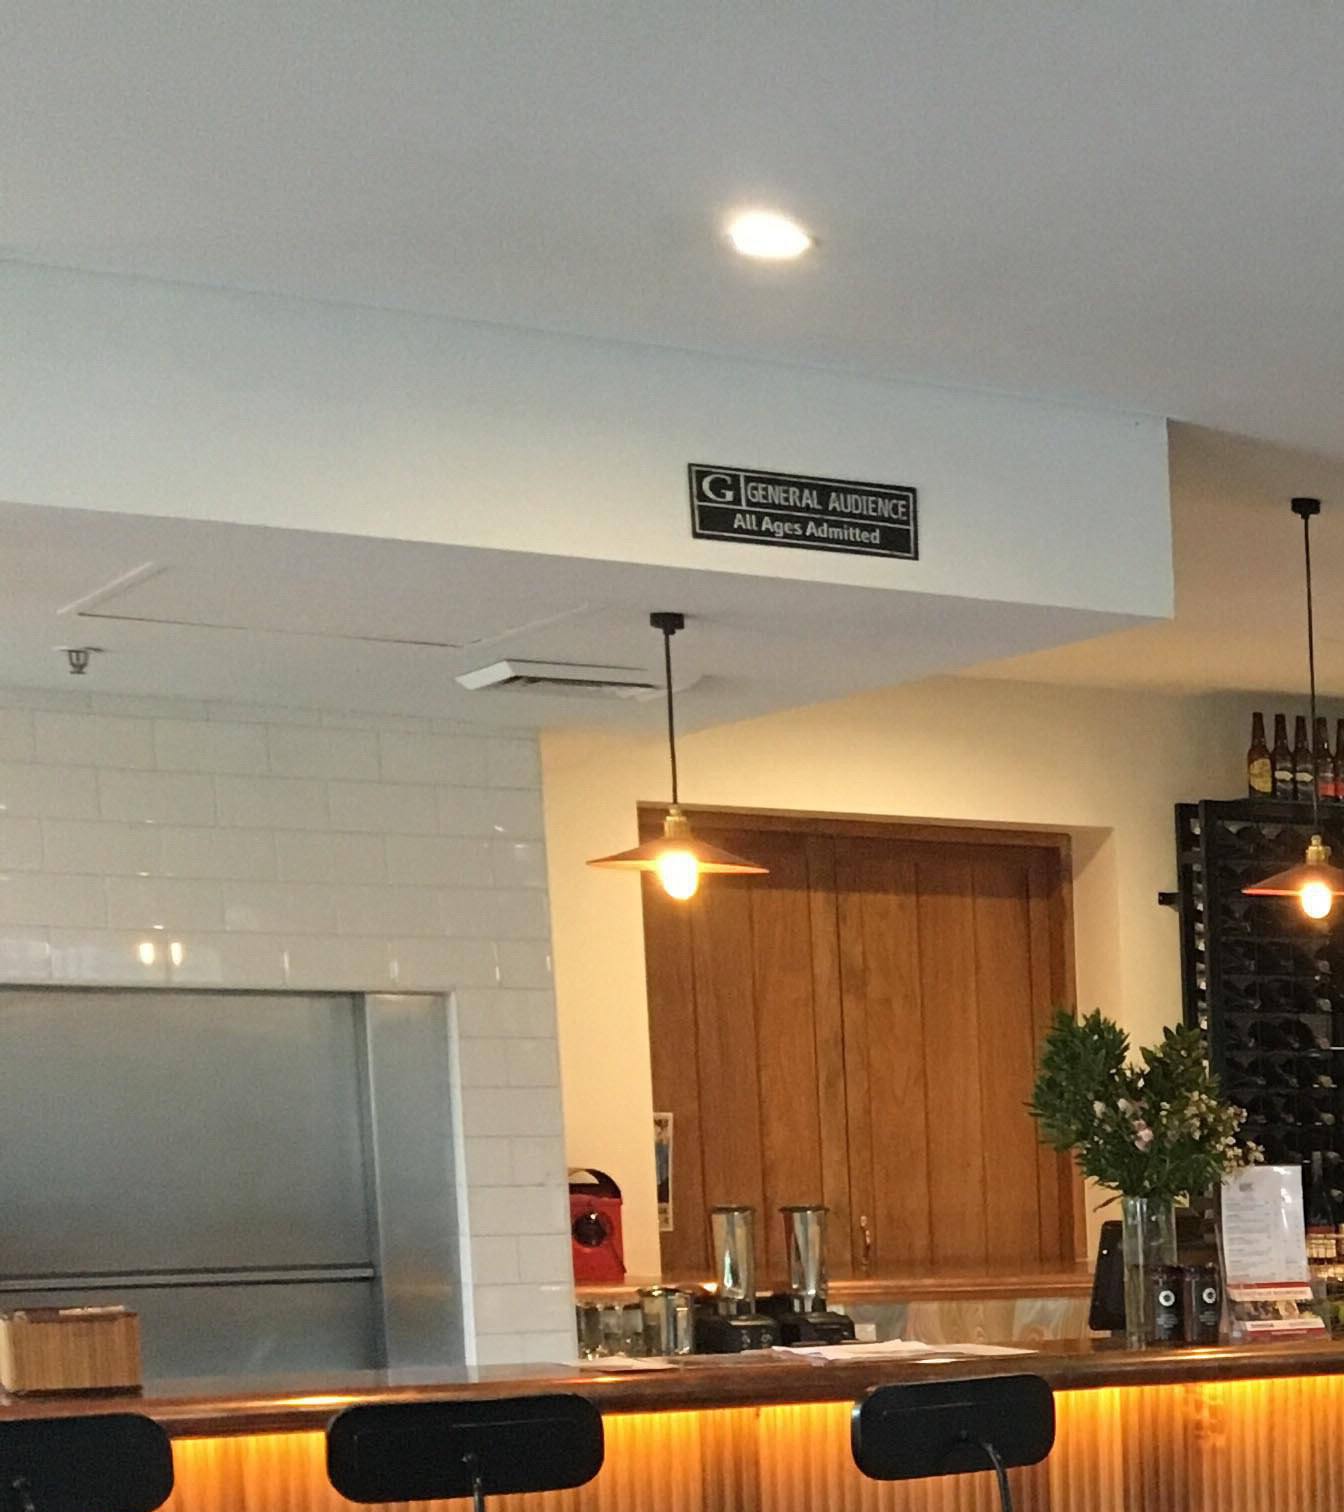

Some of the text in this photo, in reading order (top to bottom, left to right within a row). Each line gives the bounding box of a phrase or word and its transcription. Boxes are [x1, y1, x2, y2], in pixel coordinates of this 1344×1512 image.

[702, 474, 908, 520] G GENERAL AUDIENCE
[733, 513, 880, 544] All Ages Admitted
